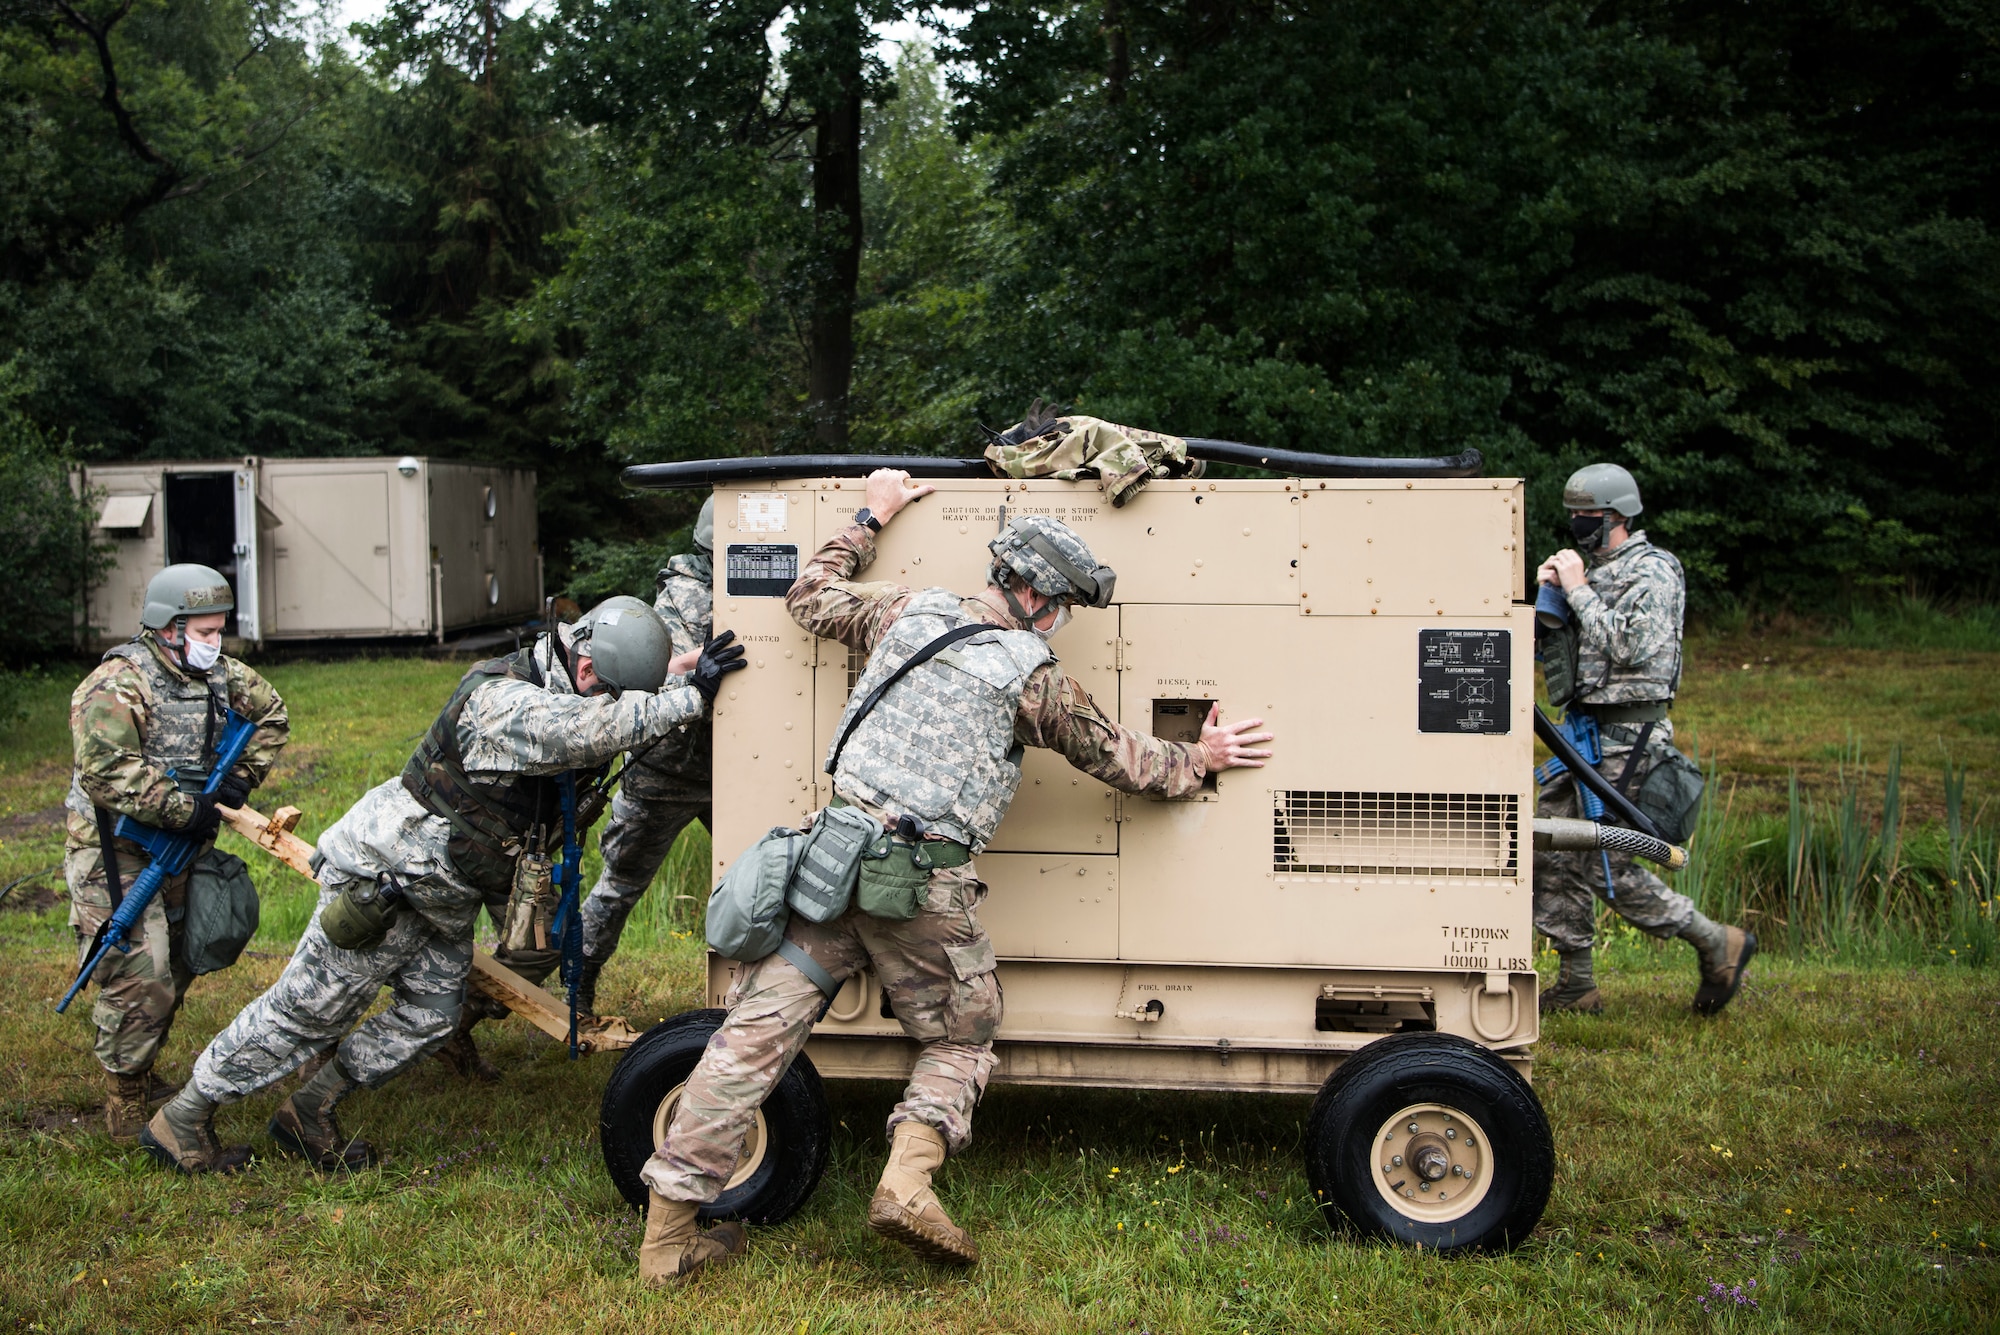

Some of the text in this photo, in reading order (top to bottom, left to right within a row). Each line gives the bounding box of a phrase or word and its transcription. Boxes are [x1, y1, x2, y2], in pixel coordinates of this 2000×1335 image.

[1072, 507, 1099, 515] STORE
[742, 635, 780, 643] PAINTED
[1157, 678, 1218, 687] DIESEL FUEL
[339, 919, 354, 934] US
[1441, 926, 1509, 939] TIEDOWN
[1451, 940, 1489, 953] LIFT
[1444, 955, 1527, 970] 10000 LBS
[1165, 984, 1193, 992] DRAIN
